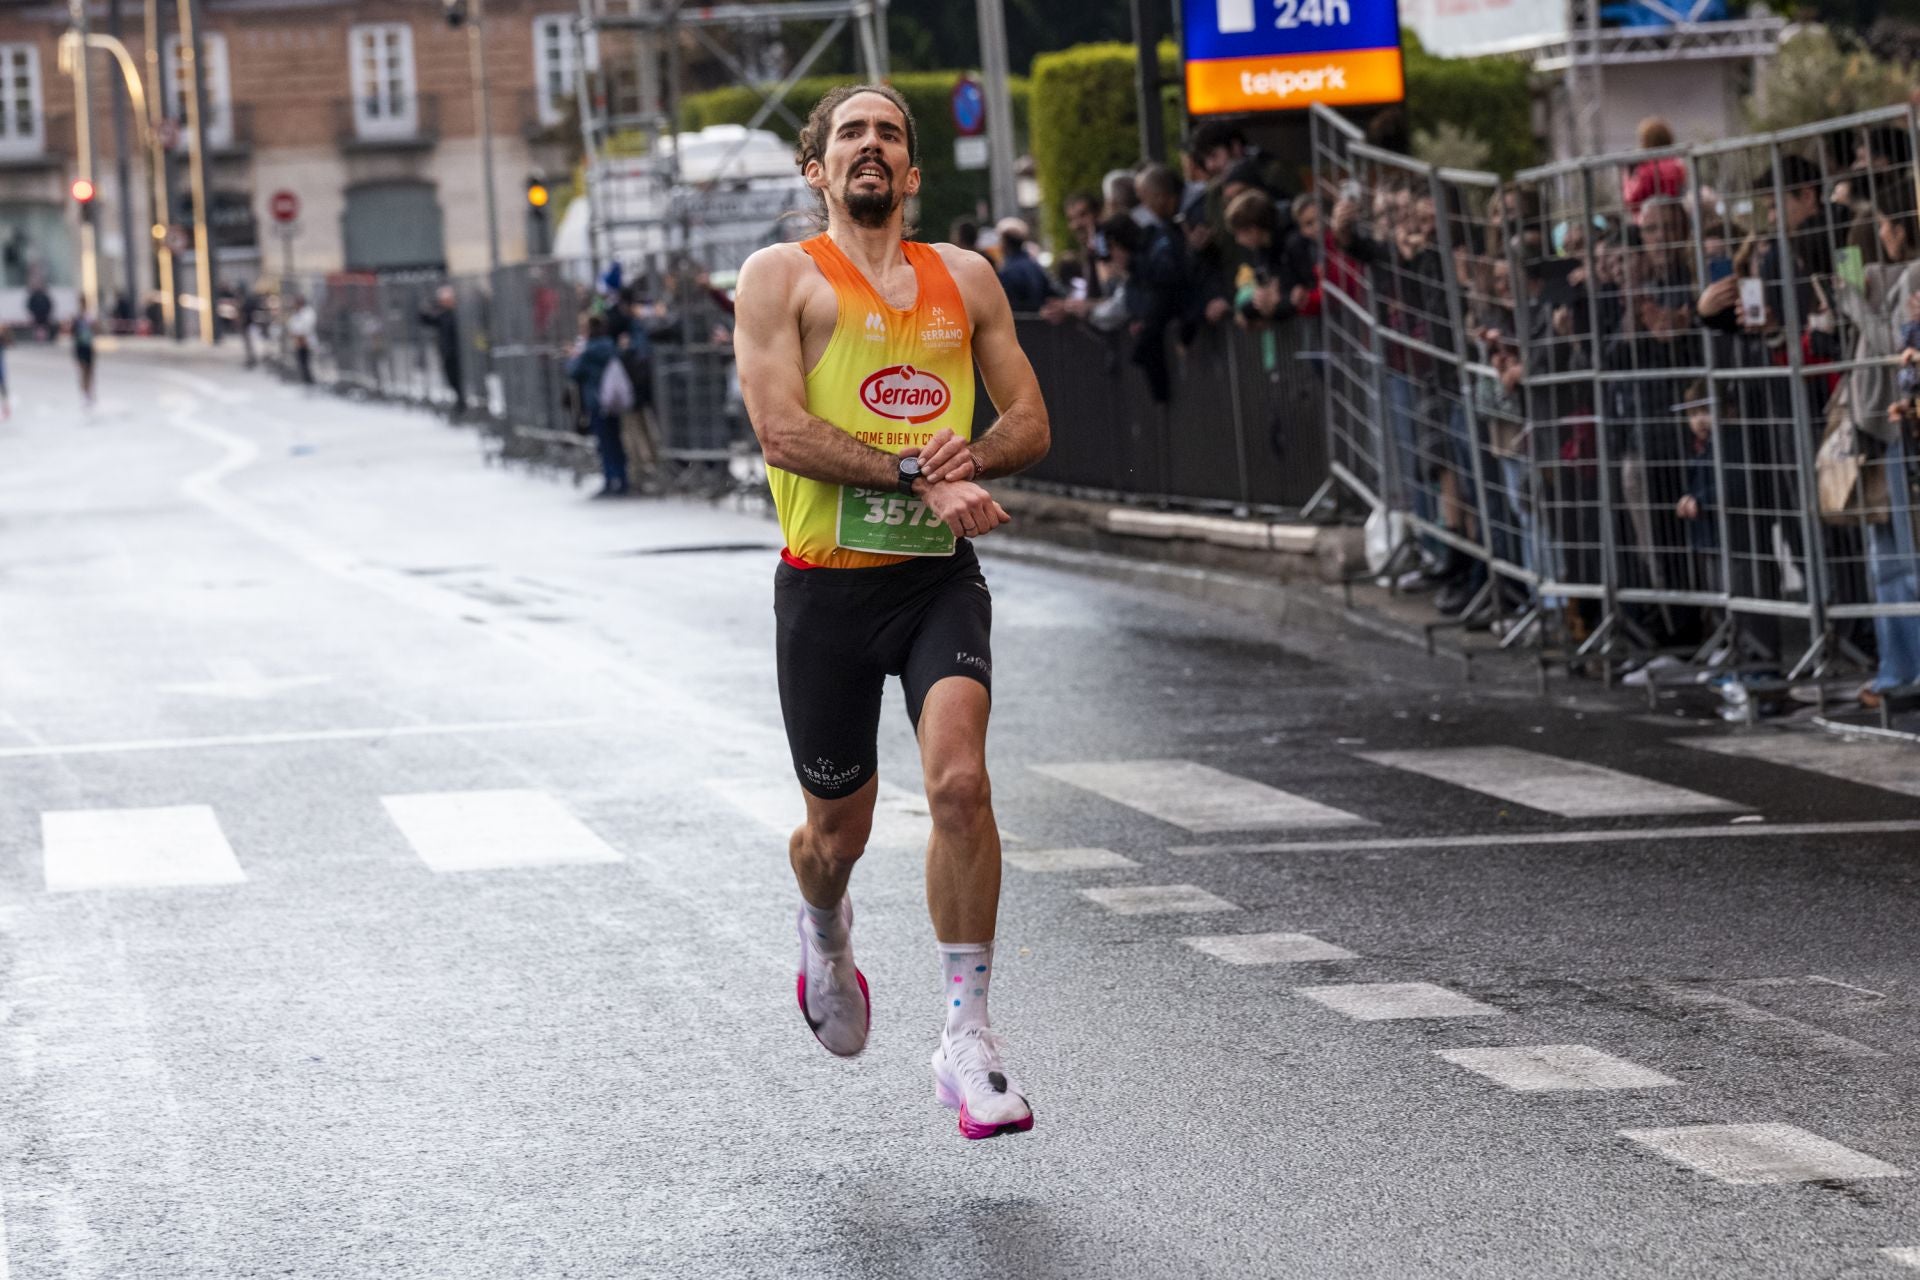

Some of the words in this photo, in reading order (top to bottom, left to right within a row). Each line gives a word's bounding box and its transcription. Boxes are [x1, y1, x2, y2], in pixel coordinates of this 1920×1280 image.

[1274, 0, 1350, 29] 24h
[1240, 65, 1346, 98] telpark
[920, 329, 963, 341] SERRANO
[869, 379, 943, 406] Serrano
[855, 431, 883, 445] COME
[887, 433, 910, 445] BIEN
[913, 433, 920, 446] Y
[803, 764, 861, 781] SERRANO
